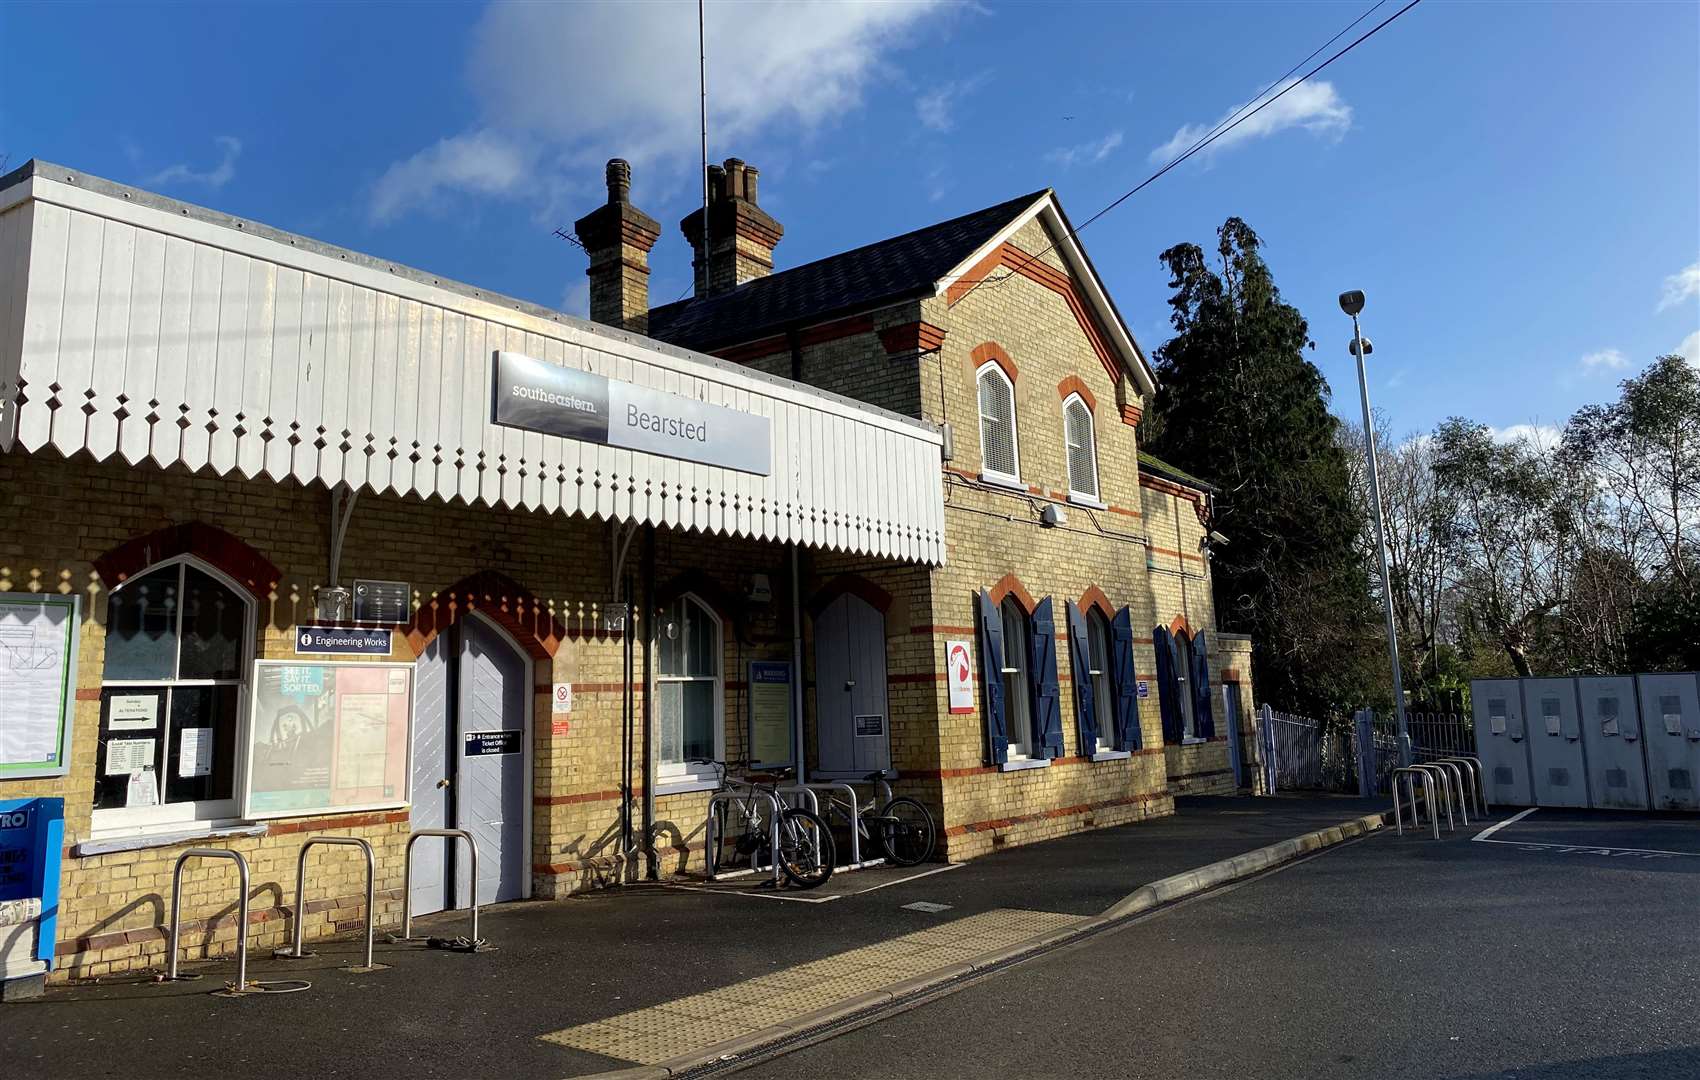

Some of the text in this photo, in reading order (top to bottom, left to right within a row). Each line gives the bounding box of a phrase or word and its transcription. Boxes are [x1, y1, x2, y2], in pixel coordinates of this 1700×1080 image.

[627, 403, 707, 443] Bearsted
[316, 636, 387, 648] Engineering Works
[283, 675, 301, 683] SAY
[283, 683, 321, 693] SORTED.
[0, 813, 26, 828] RO
